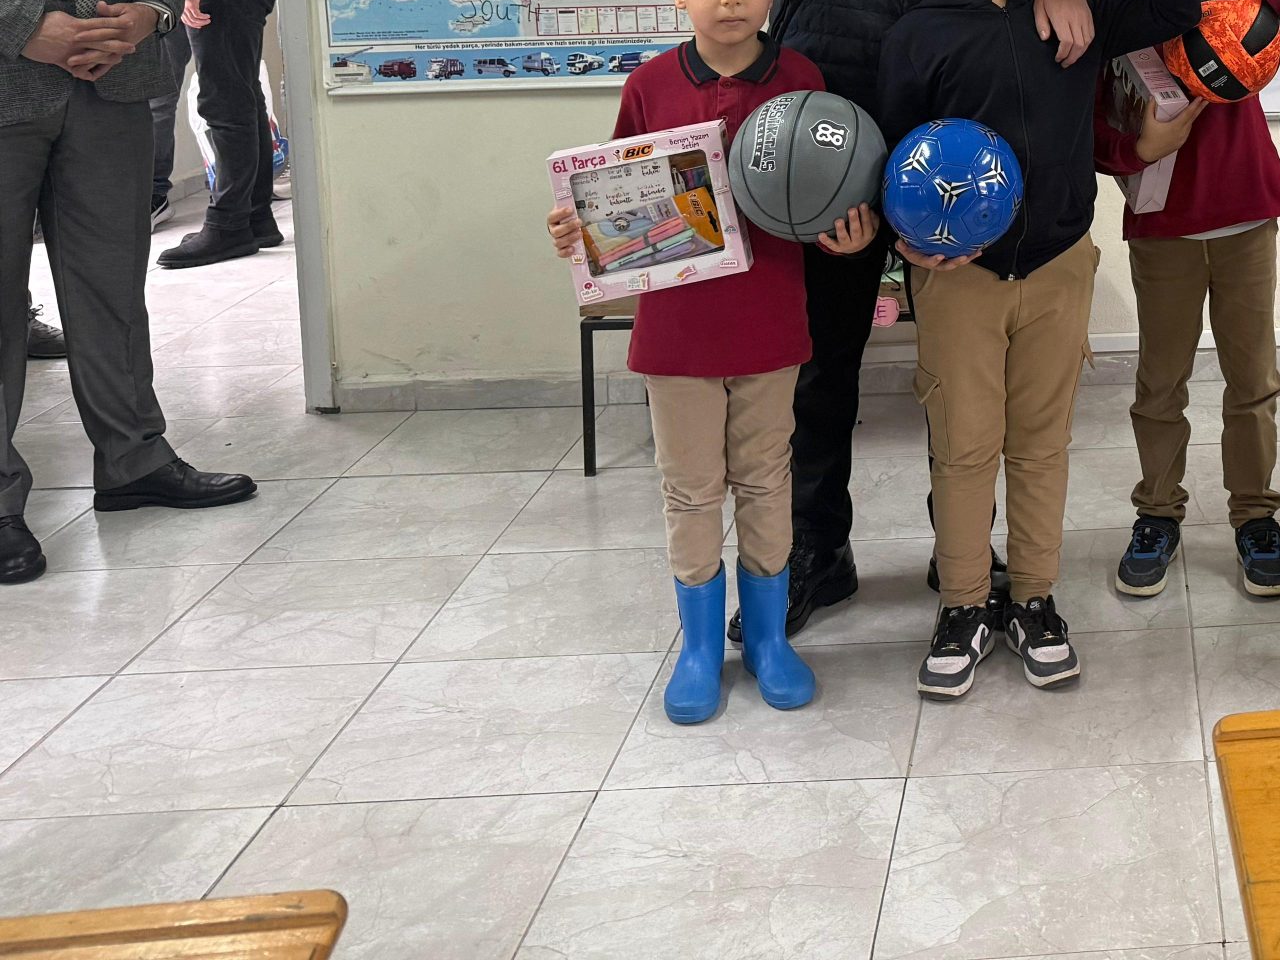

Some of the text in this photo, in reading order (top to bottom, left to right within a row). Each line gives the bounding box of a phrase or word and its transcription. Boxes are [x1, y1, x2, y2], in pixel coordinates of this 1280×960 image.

[669, 132, 710, 146] Benim Yazım
[552, 155, 607, 174] 61 Parça
